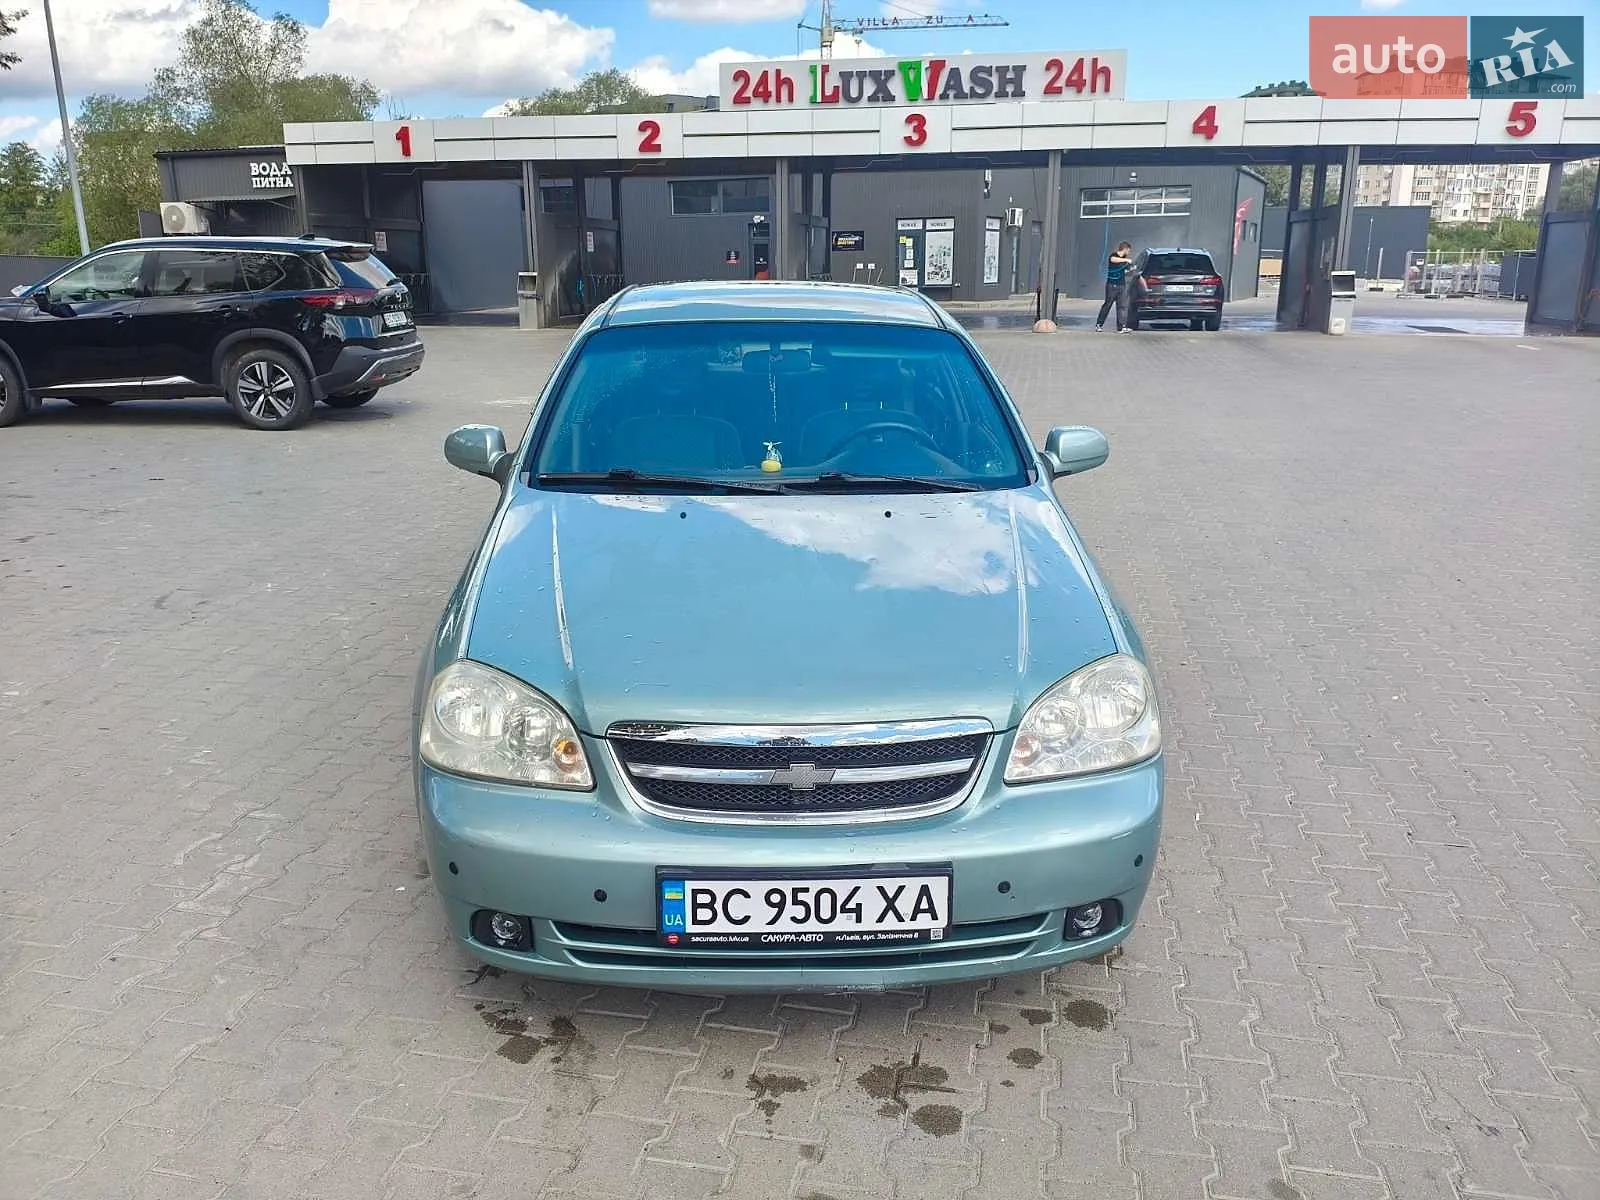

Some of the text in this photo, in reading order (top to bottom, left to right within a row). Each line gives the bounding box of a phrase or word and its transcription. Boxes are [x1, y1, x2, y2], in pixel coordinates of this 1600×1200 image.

[856, 16, 899, 26] VILLA
[732, 69, 794, 105] 24h
[1043, 57, 1112, 95] 24h
[904, 113, 928, 146] 3
[1192, 105, 1219, 140] 4
[1505, 101, 1538, 137] 5
[395, 126, 412, 157] 1
[638, 120, 662, 152] 2
[250, 162, 292, 176] ВОДА
[252, 177, 294, 188] ПИТНА
[665, 914, 684, 927] UA
[691, 884, 939, 926] BC 9504 XA
[760, 933, 825, 943] САКУРА-АВТО
